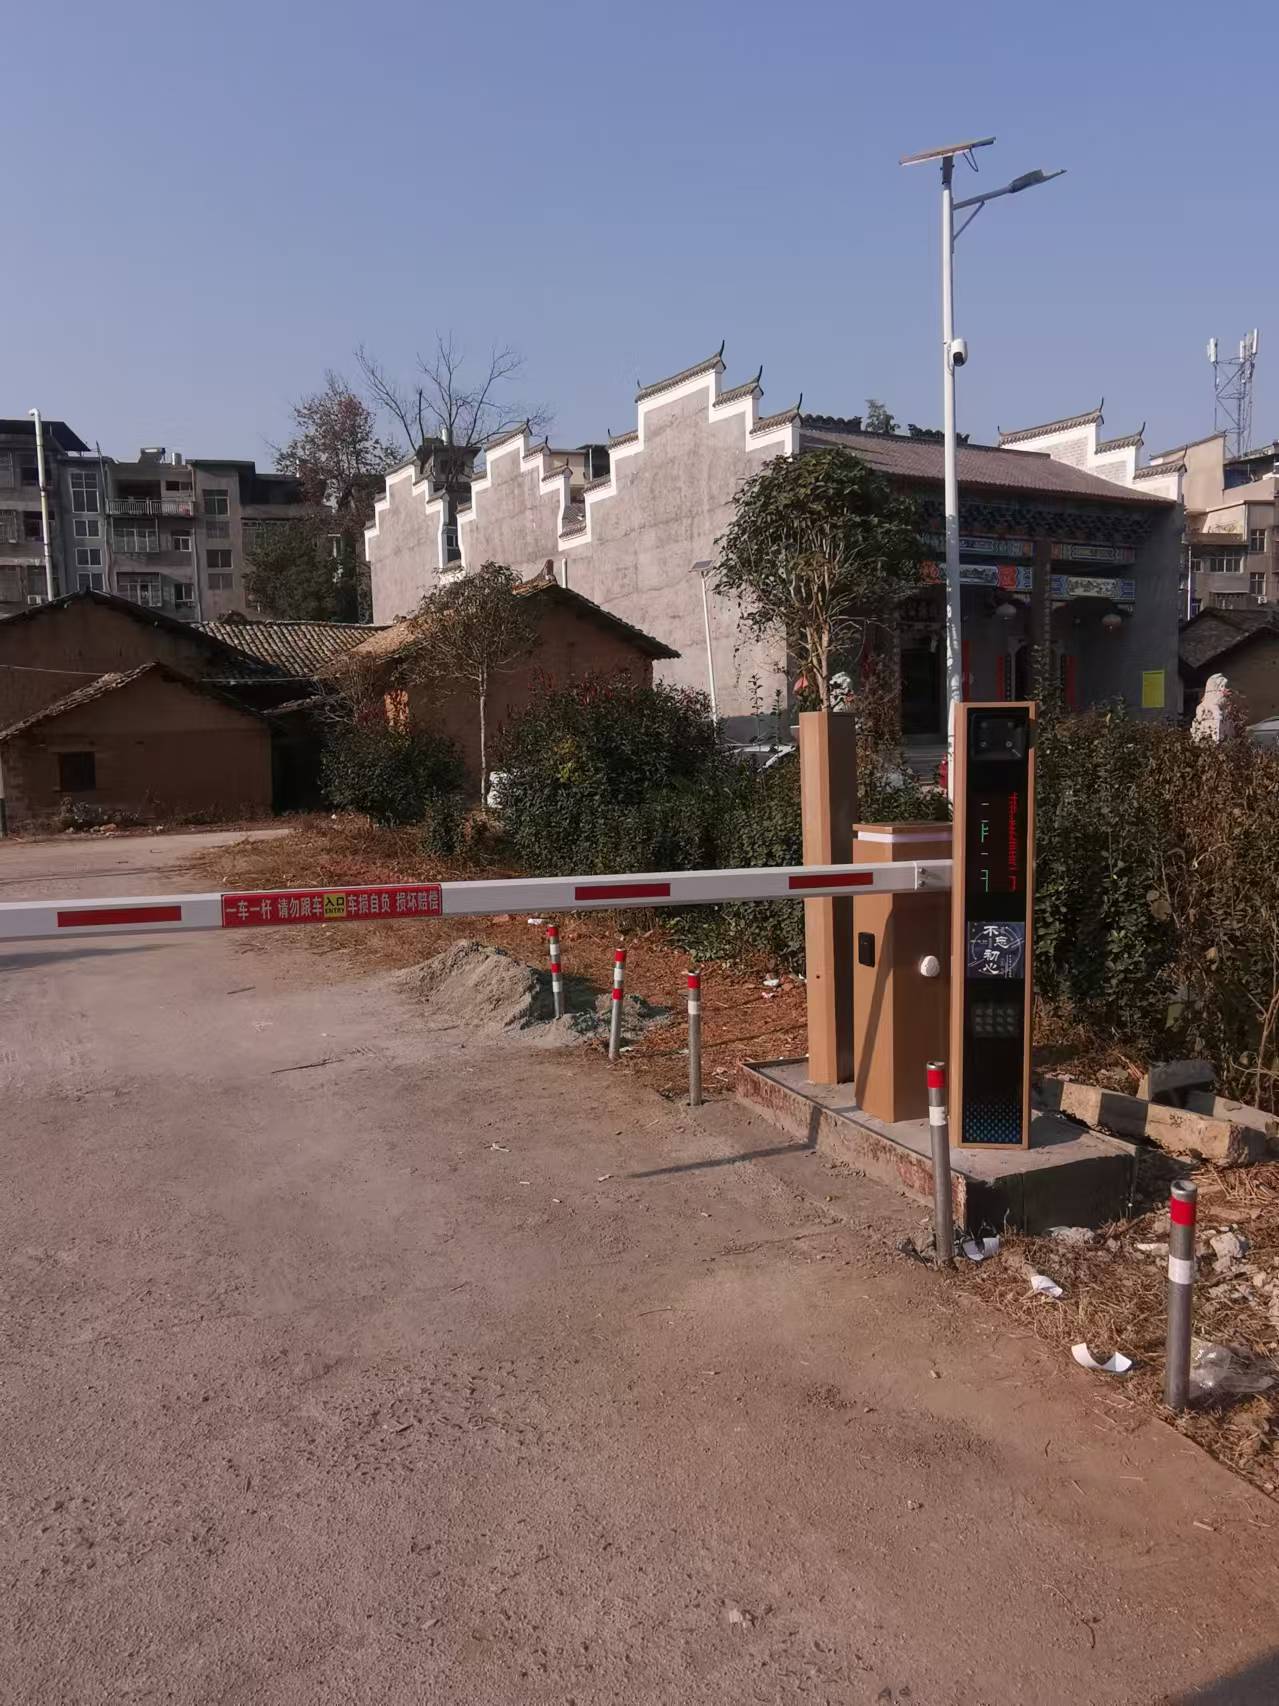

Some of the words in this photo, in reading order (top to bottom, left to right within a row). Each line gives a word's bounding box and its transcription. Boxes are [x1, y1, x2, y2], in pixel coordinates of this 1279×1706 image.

[226, 899, 272, 920] 一车一杆
[278, 896, 323, 919] 请勿跟车
[325, 897, 344, 907] 入口
[348, 893, 391, 914] 车损自负
[396, 890, 439, 912] 损坏赔偿
